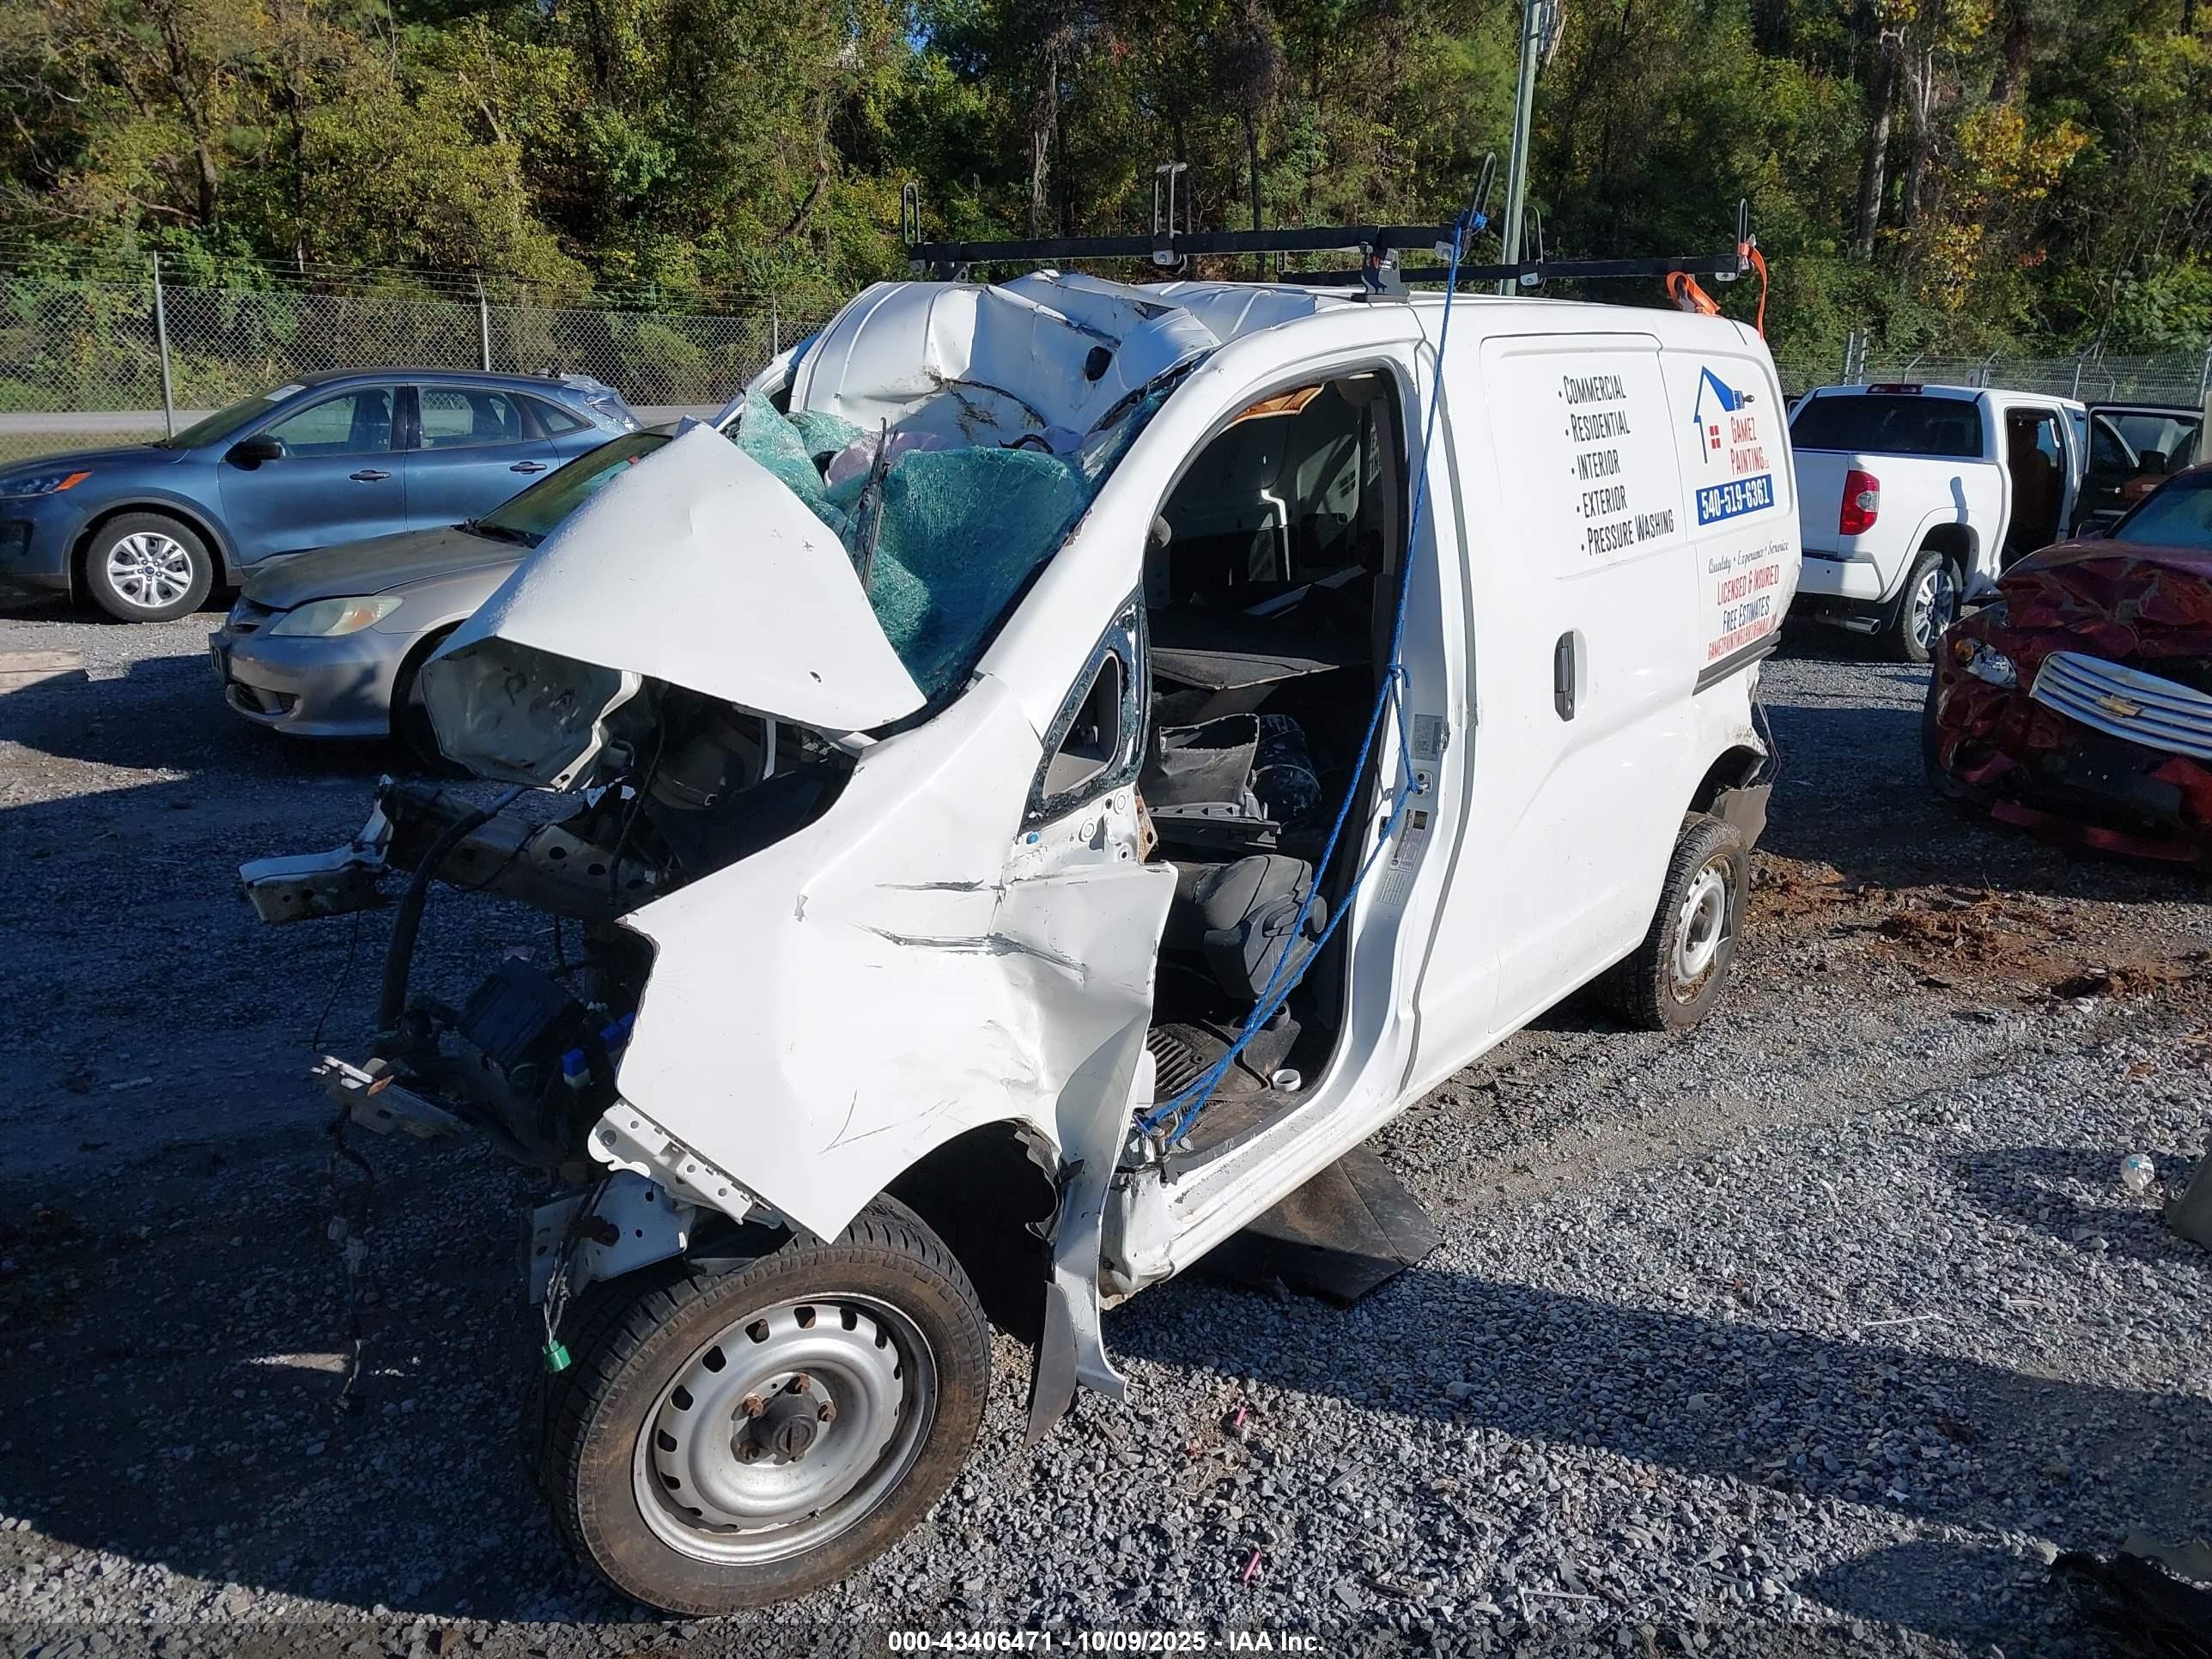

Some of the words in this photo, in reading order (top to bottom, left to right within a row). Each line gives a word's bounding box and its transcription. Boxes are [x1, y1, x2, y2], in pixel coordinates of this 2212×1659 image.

[1563, 374, 1627, 405] COMMERCIAL
[1570, 410, 1632, 443] RESIDENTIAL
[1730, 416, 1757, 444] GAMEZ
[1577, 449, 1621, 481] INTERIOR
[1729, 446, 1765, 476] PAINTING
[1582, 484, 1628, 519] EXTERIOR
[1700, 477, 1771, 520] 540-519-6361
[1587, 520, 1635, 556] PRESSURE
[1635, 508, 1674, 543] WASHING
[1708, 555, 1732, 574] Quality
[1717, 575, 1747, 606] LICENSED
[1753, 563, 1780, 592] INSURED
[1723, 608, 1738, 635] FREE
[1738, 595, 1771, 628] ESTIMATES
